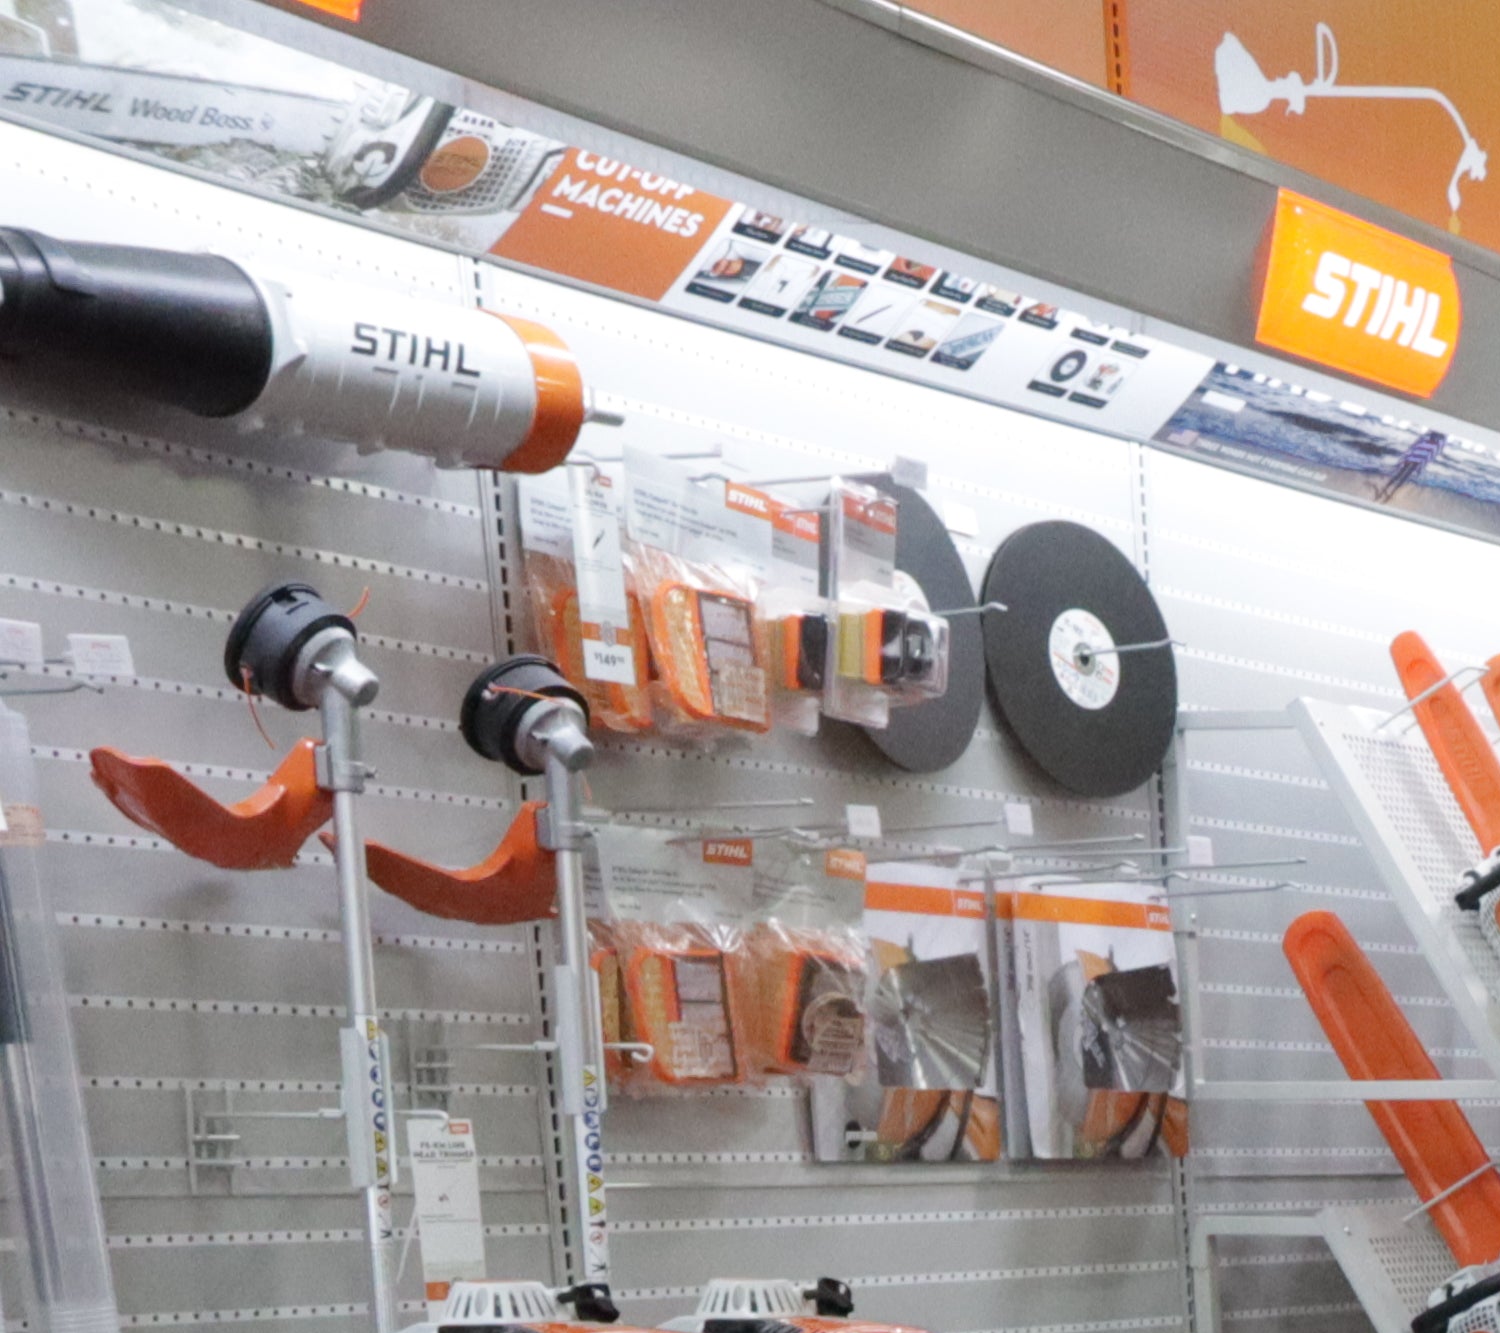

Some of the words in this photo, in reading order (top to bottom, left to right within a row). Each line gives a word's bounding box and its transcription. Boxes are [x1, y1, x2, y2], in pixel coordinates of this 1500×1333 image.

[2, 82, 112, 115] STIHL
[128, 98, 199, 126] Wood
[199, 106, 252, 131] Boss
[552, 174, 705, 238] MACHINES
[1302, 250, 1448, 357] STIHL
[351, 321, 482, 379] STIHL
[727, 489, 768, 513] STIHL
[705, 842, 748, 860] STIHL
[830, 856, 863, 874] STIHL
[957, 896, 984, 913] STIHL
